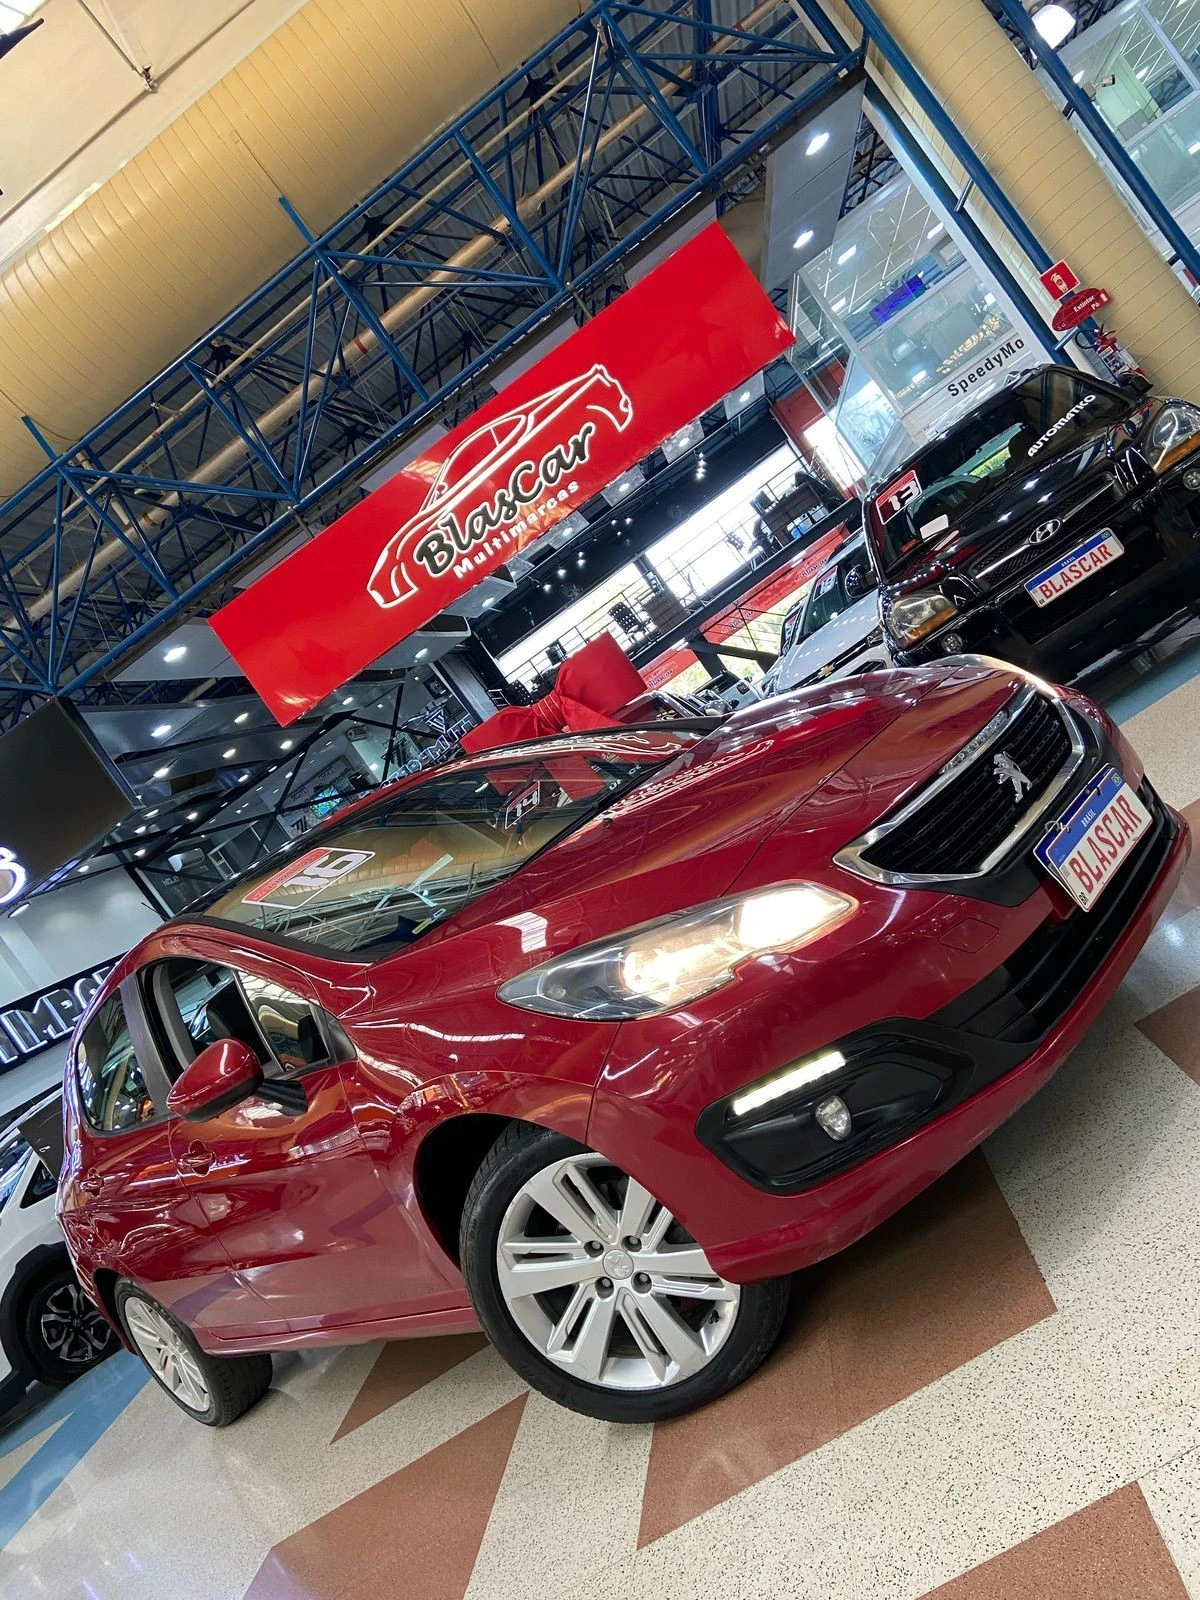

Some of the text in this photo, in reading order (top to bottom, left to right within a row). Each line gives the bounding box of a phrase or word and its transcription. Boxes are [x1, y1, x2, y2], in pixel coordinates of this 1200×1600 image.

[414, 422, 595, 577] BlasCar
[888, 480, 920, 511] 13
[452, 480, 579, 579] Multimarcas
[1039, 543, 1113, 599] BLASCAR
[1068, 794, 1142, 894] BLASCAR
[1080, 809, 1096, 828] BRASIL
[282, 853, 367, 888] 16
